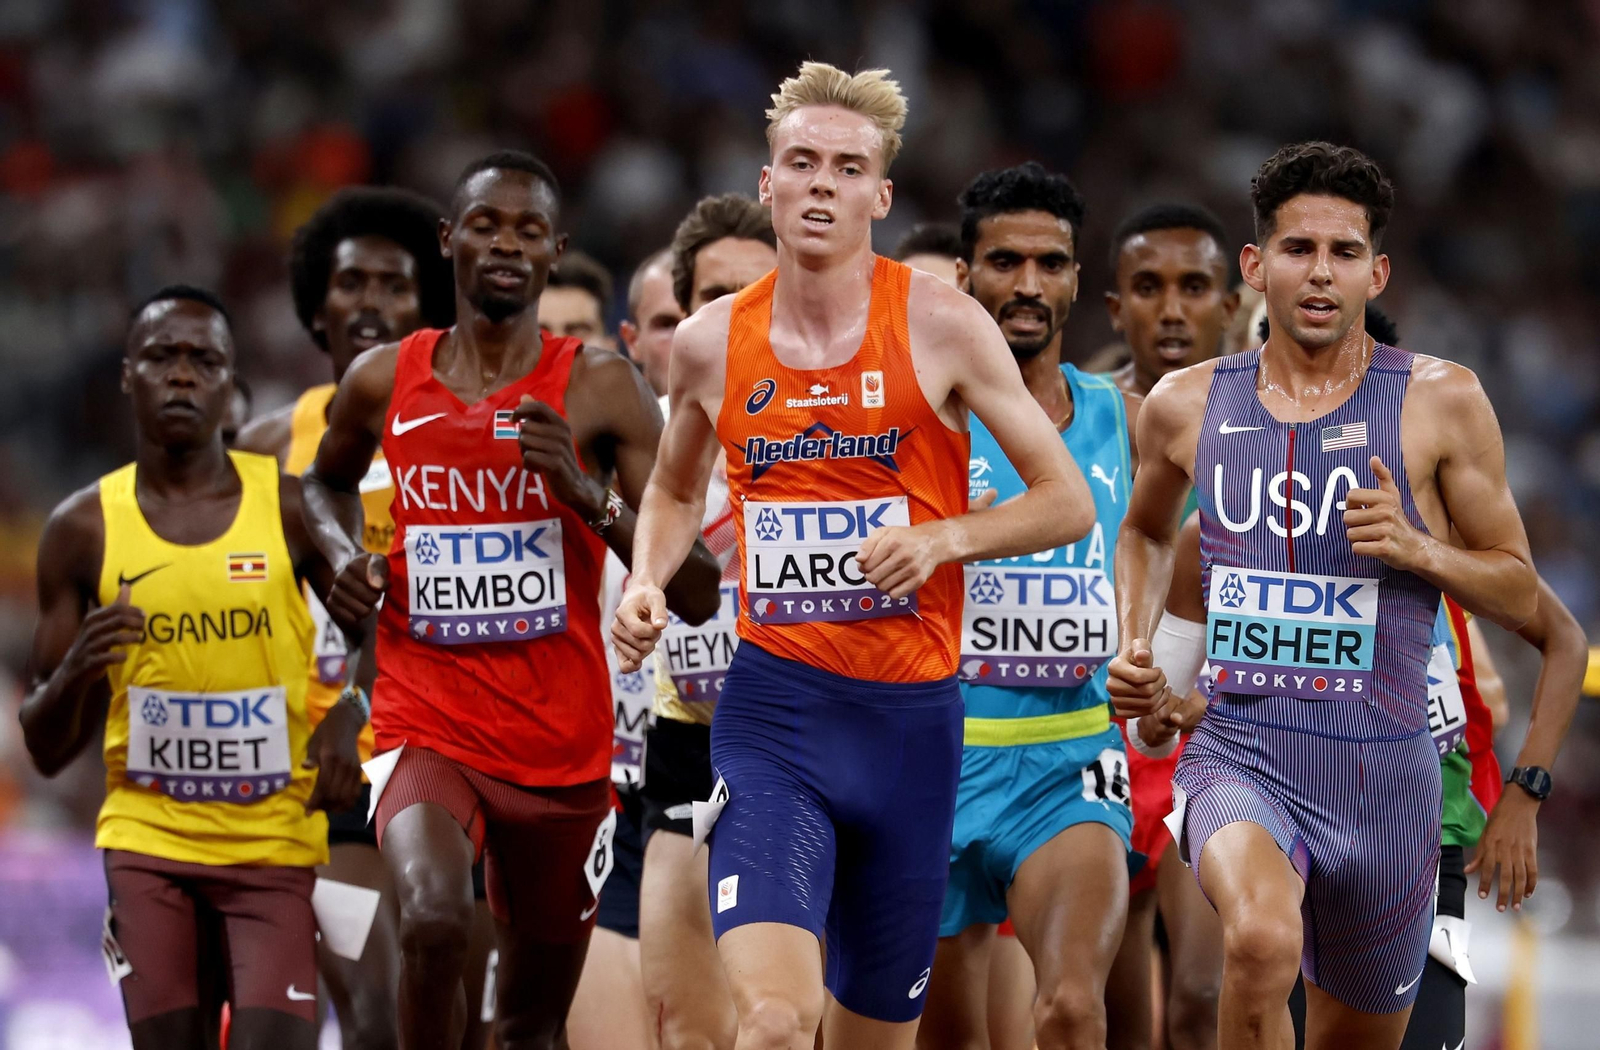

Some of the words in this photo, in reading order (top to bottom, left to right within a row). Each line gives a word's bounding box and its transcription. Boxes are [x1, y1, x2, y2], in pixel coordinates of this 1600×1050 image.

[785, 393, 849, 409] Staatsloterij
[744, 427, 900, 465] Nederland
[396, 464, 549, 512] KENYA
[1213, 463, 1366, 538] USA
[781, 502, 893, 541] TDK
[439, 527, 550, 565] TDK
[416, 568, 556, 610] KEMBOI
[755, 551, 874, 589] LARO
[1004, 572, 1110, 606] TDK
[1246, 574, 1365, 619] TDK
[142, 606, 273, 645] GANDA
[970, 616, 1108, 652] SINGH
[1211, 618, 1363, 666] FISHER
[168, 694, 273, 729] TDK
[149, 736, 268, 771] KIBET
